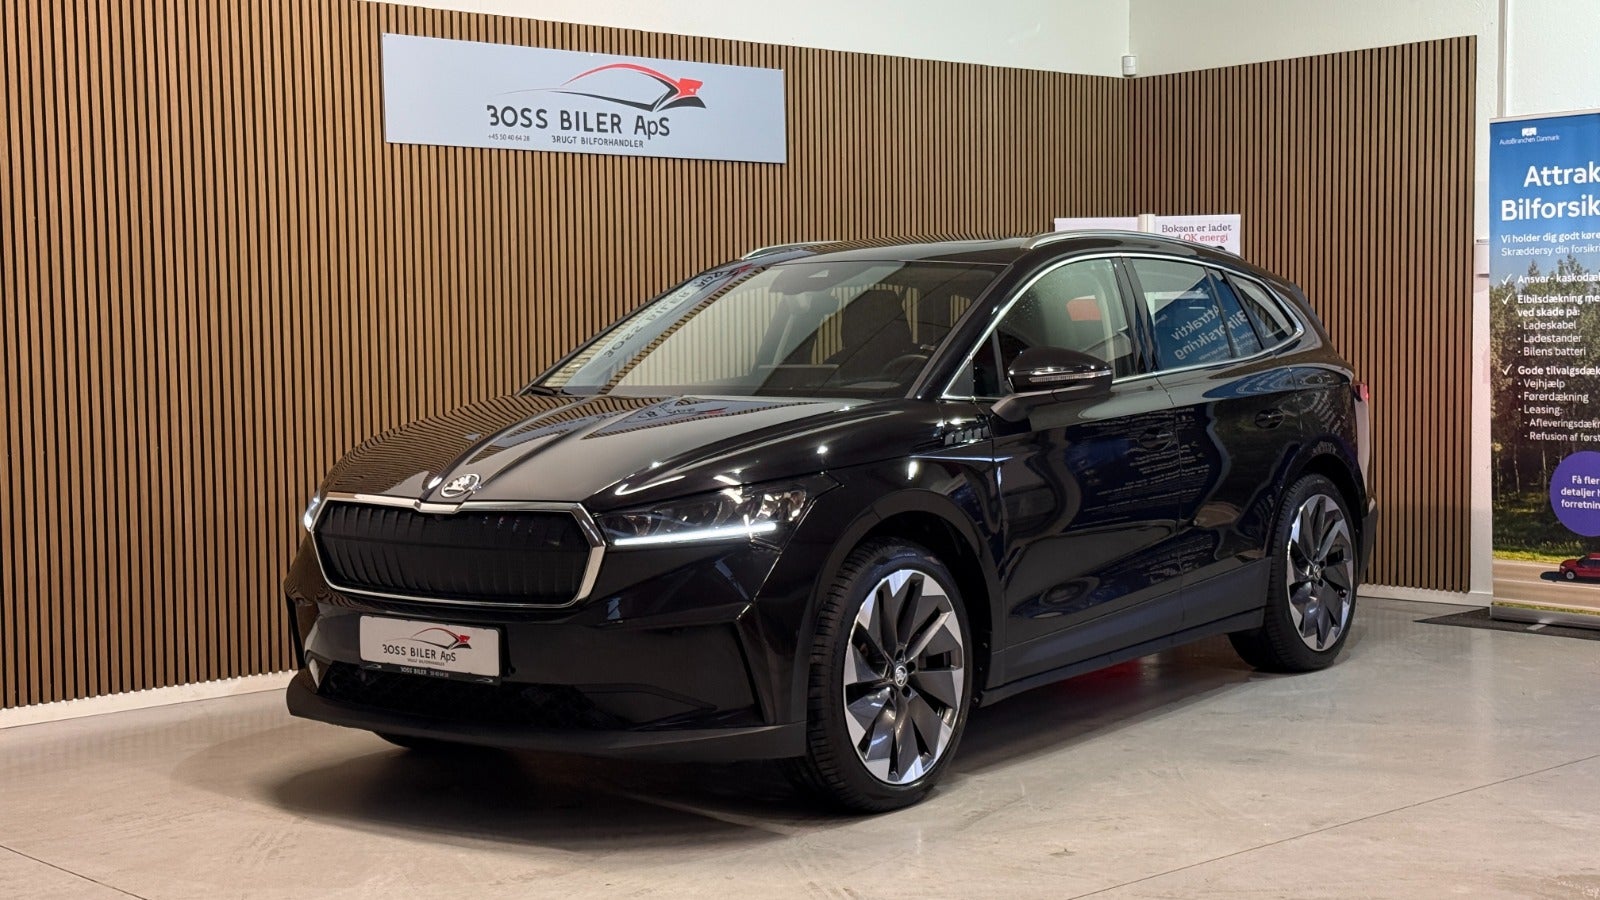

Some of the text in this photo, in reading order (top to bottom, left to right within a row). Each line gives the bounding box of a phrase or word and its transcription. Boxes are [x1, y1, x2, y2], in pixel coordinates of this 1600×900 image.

[560, 110, 622, 134] BILER
[634, 115, 670, 140] ApS
[581, 137, 644, 148] BILFORHANDLER
[1524, 161, 1600, 187] Attrak
[1502, 194, 1600, 221] Bilforsik
[1161, 224, 1194, 233] Boksen
[1208, 223, 1232, 232] ladet
[1183, 233, 1198, 242] OK
[1199, 234, 1228, 243] energi
[1501, 234, 1511, 243] Vi
[1512, 233, 1541, 243] holder
[1543, 232, 1557, 243] dig
[1559, 231, 1580, 243] godt
[1501, 246, 1553, 256] Skræddersy
[1555, 245, 1569, 254] din
[1517, 293, 1583, 304] Elbilsdækning
[1517, 306, 1580, 317] ved skade på:
[1523, 320, 1577, 329] Ladeskabel
[1523, 334, 1582, 342] Ladestander
[1523, 347, 1586, 356] Bilens batteri
[1518, 366, 1544, 375] Gode
[1523, 379, 1566, 390] Vejhjælp
[1523, 391, 1589, 403] Førerdækning
[1529, 431, 1567, 440] Refusion
[1569, 432, 1578, 441] af
[1572, 475, 1582, 484] Få
[1561, 487, 1596, 498] detaljer
[410, 647, 436, 659] BILER
[440, 651, 456, 662] ApS
